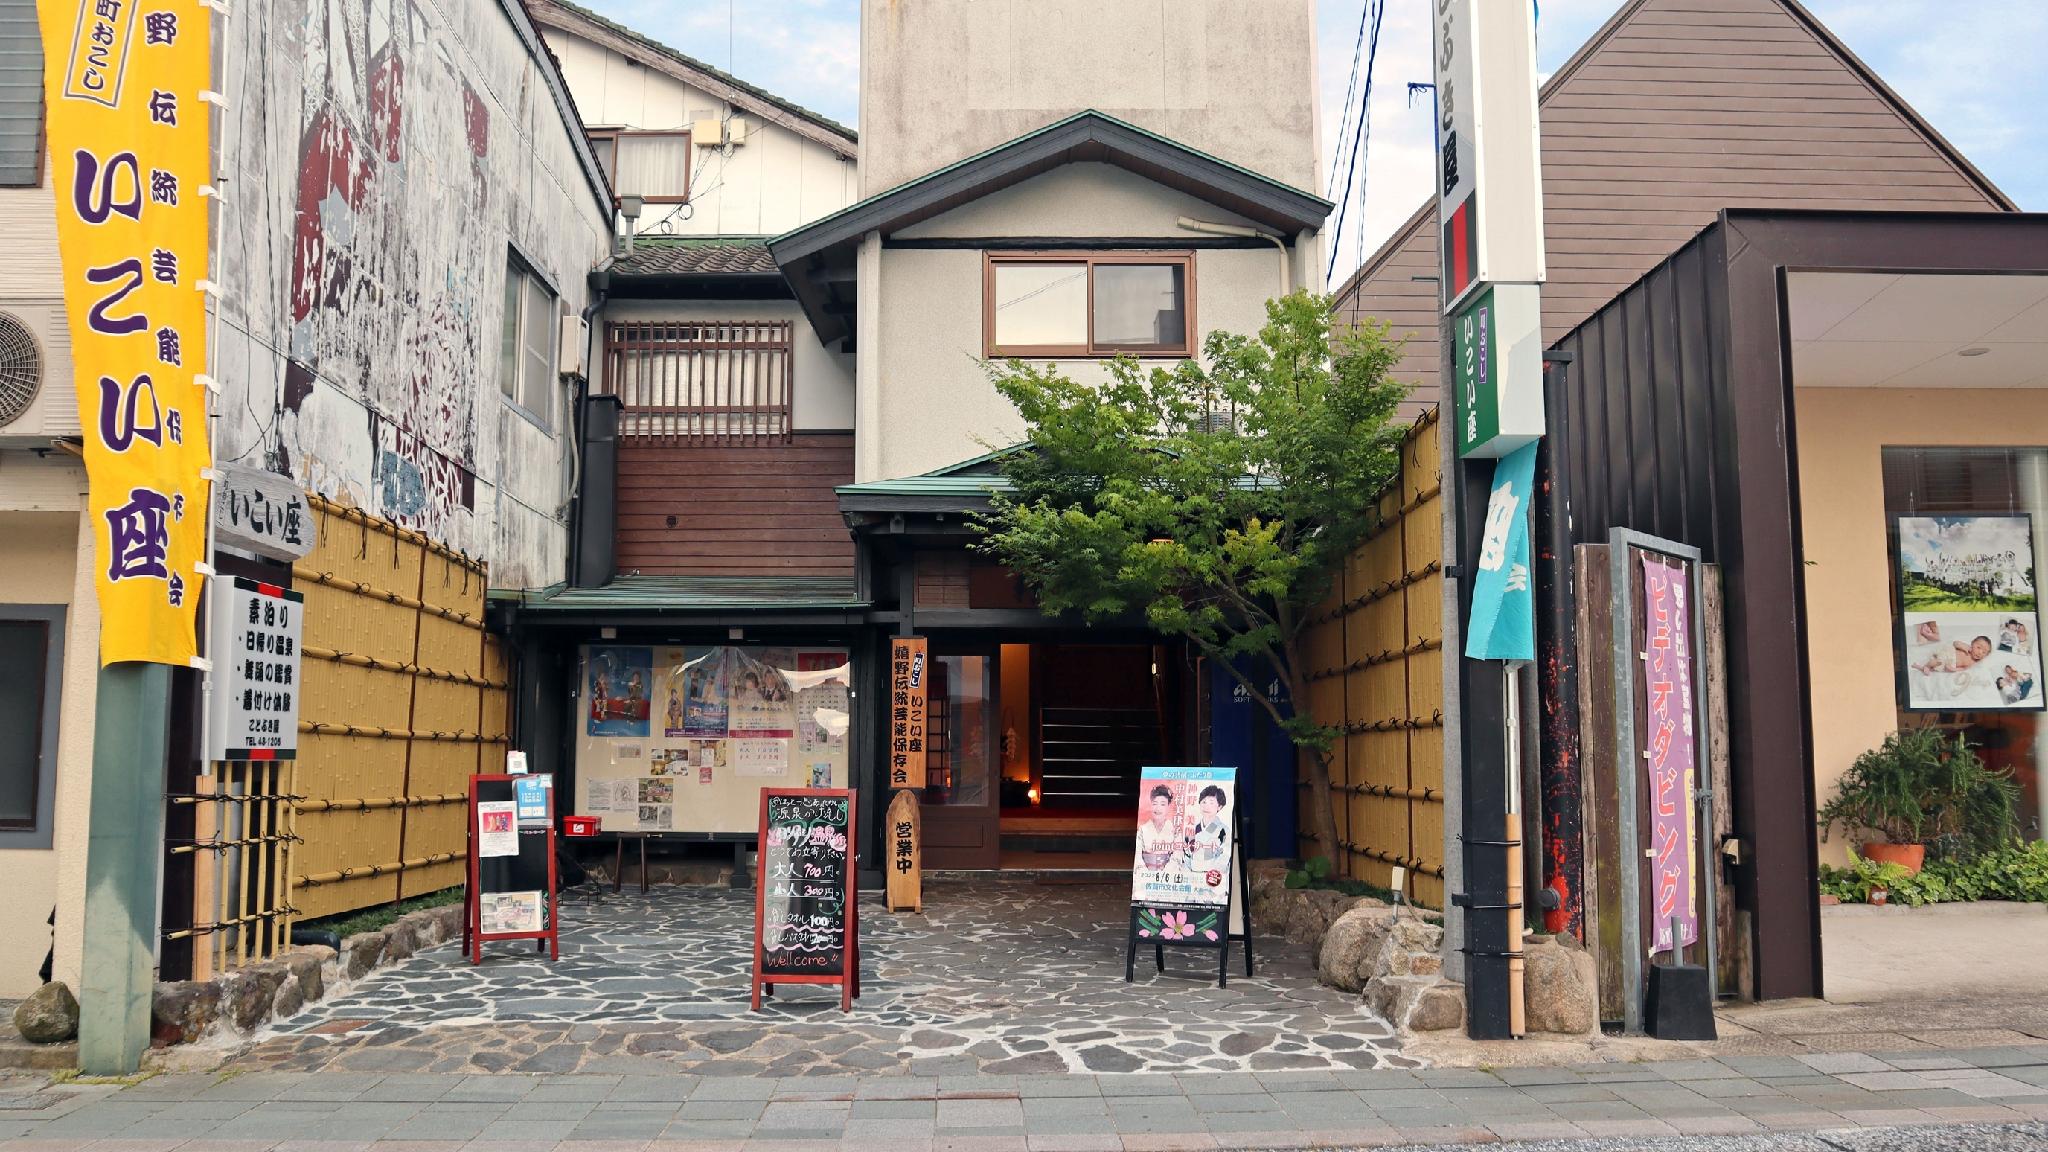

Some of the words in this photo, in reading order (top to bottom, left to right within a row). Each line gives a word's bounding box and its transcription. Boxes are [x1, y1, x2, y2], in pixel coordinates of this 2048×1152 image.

[83, 0, 122, 90] 町おこし
[74, 149, 171, 581] いこい座
[1464, 314, 1478, 444] いこい座
[231, 488, 302, 545] いこい座
[249, 597, 289, 629] 素泊り
[245, 737, 257, 747] TEL
[892, 646, 910, 783] 嬉野伝統芸能保存会
[910, 695, 923, 752] いこい座
[1650, 574, 1681, 919] ビデオダビング
[773, 862, 803, 878] 大人
[894, 822, 914, 875] 営業中
